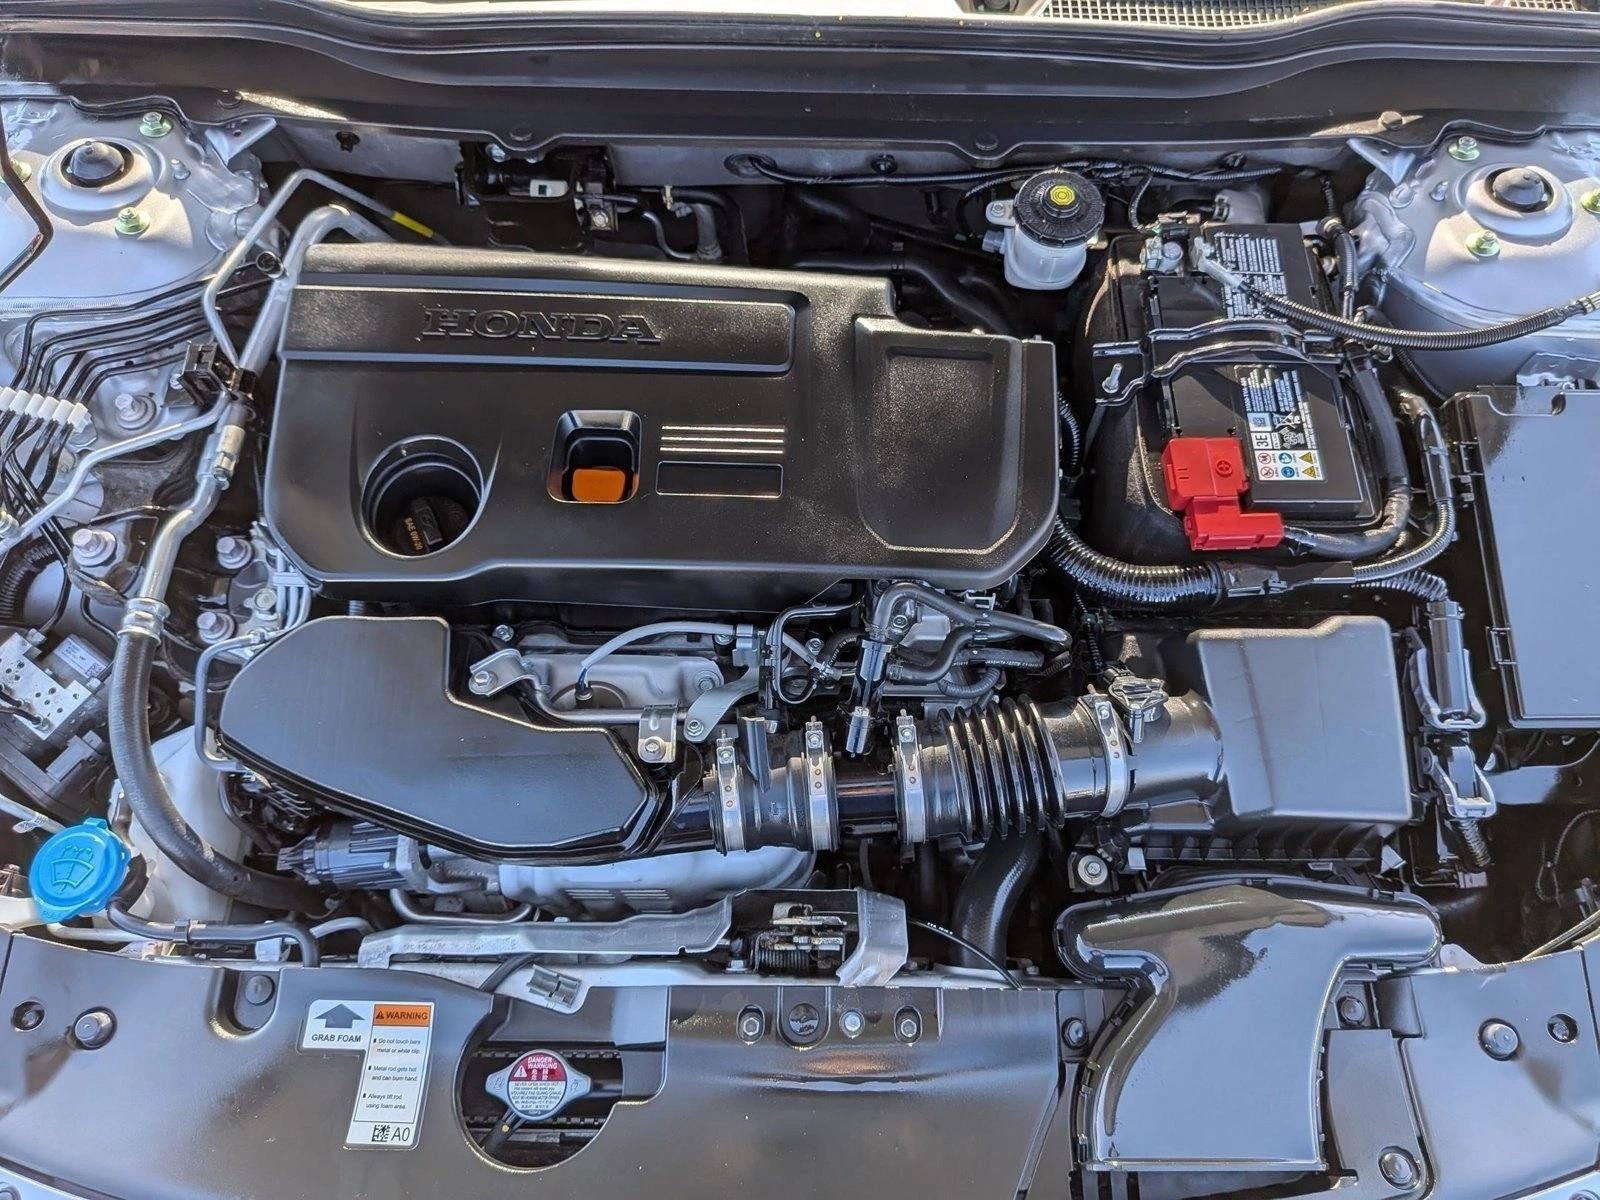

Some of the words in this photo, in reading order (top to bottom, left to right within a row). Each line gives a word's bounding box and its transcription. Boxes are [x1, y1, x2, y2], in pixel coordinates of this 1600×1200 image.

[422, 308, 663, 345] HONDA
[1254, 434, 1269, 448] 3E
[386, 1011, 428, 1020] WARNING
[311, 1033, 336, 1043] GRAB
[337, 1034, 362, 1043] FOAM
[527, 1062, 558, 1070] WARNING
[367, 1093, 386, 1101] Always
